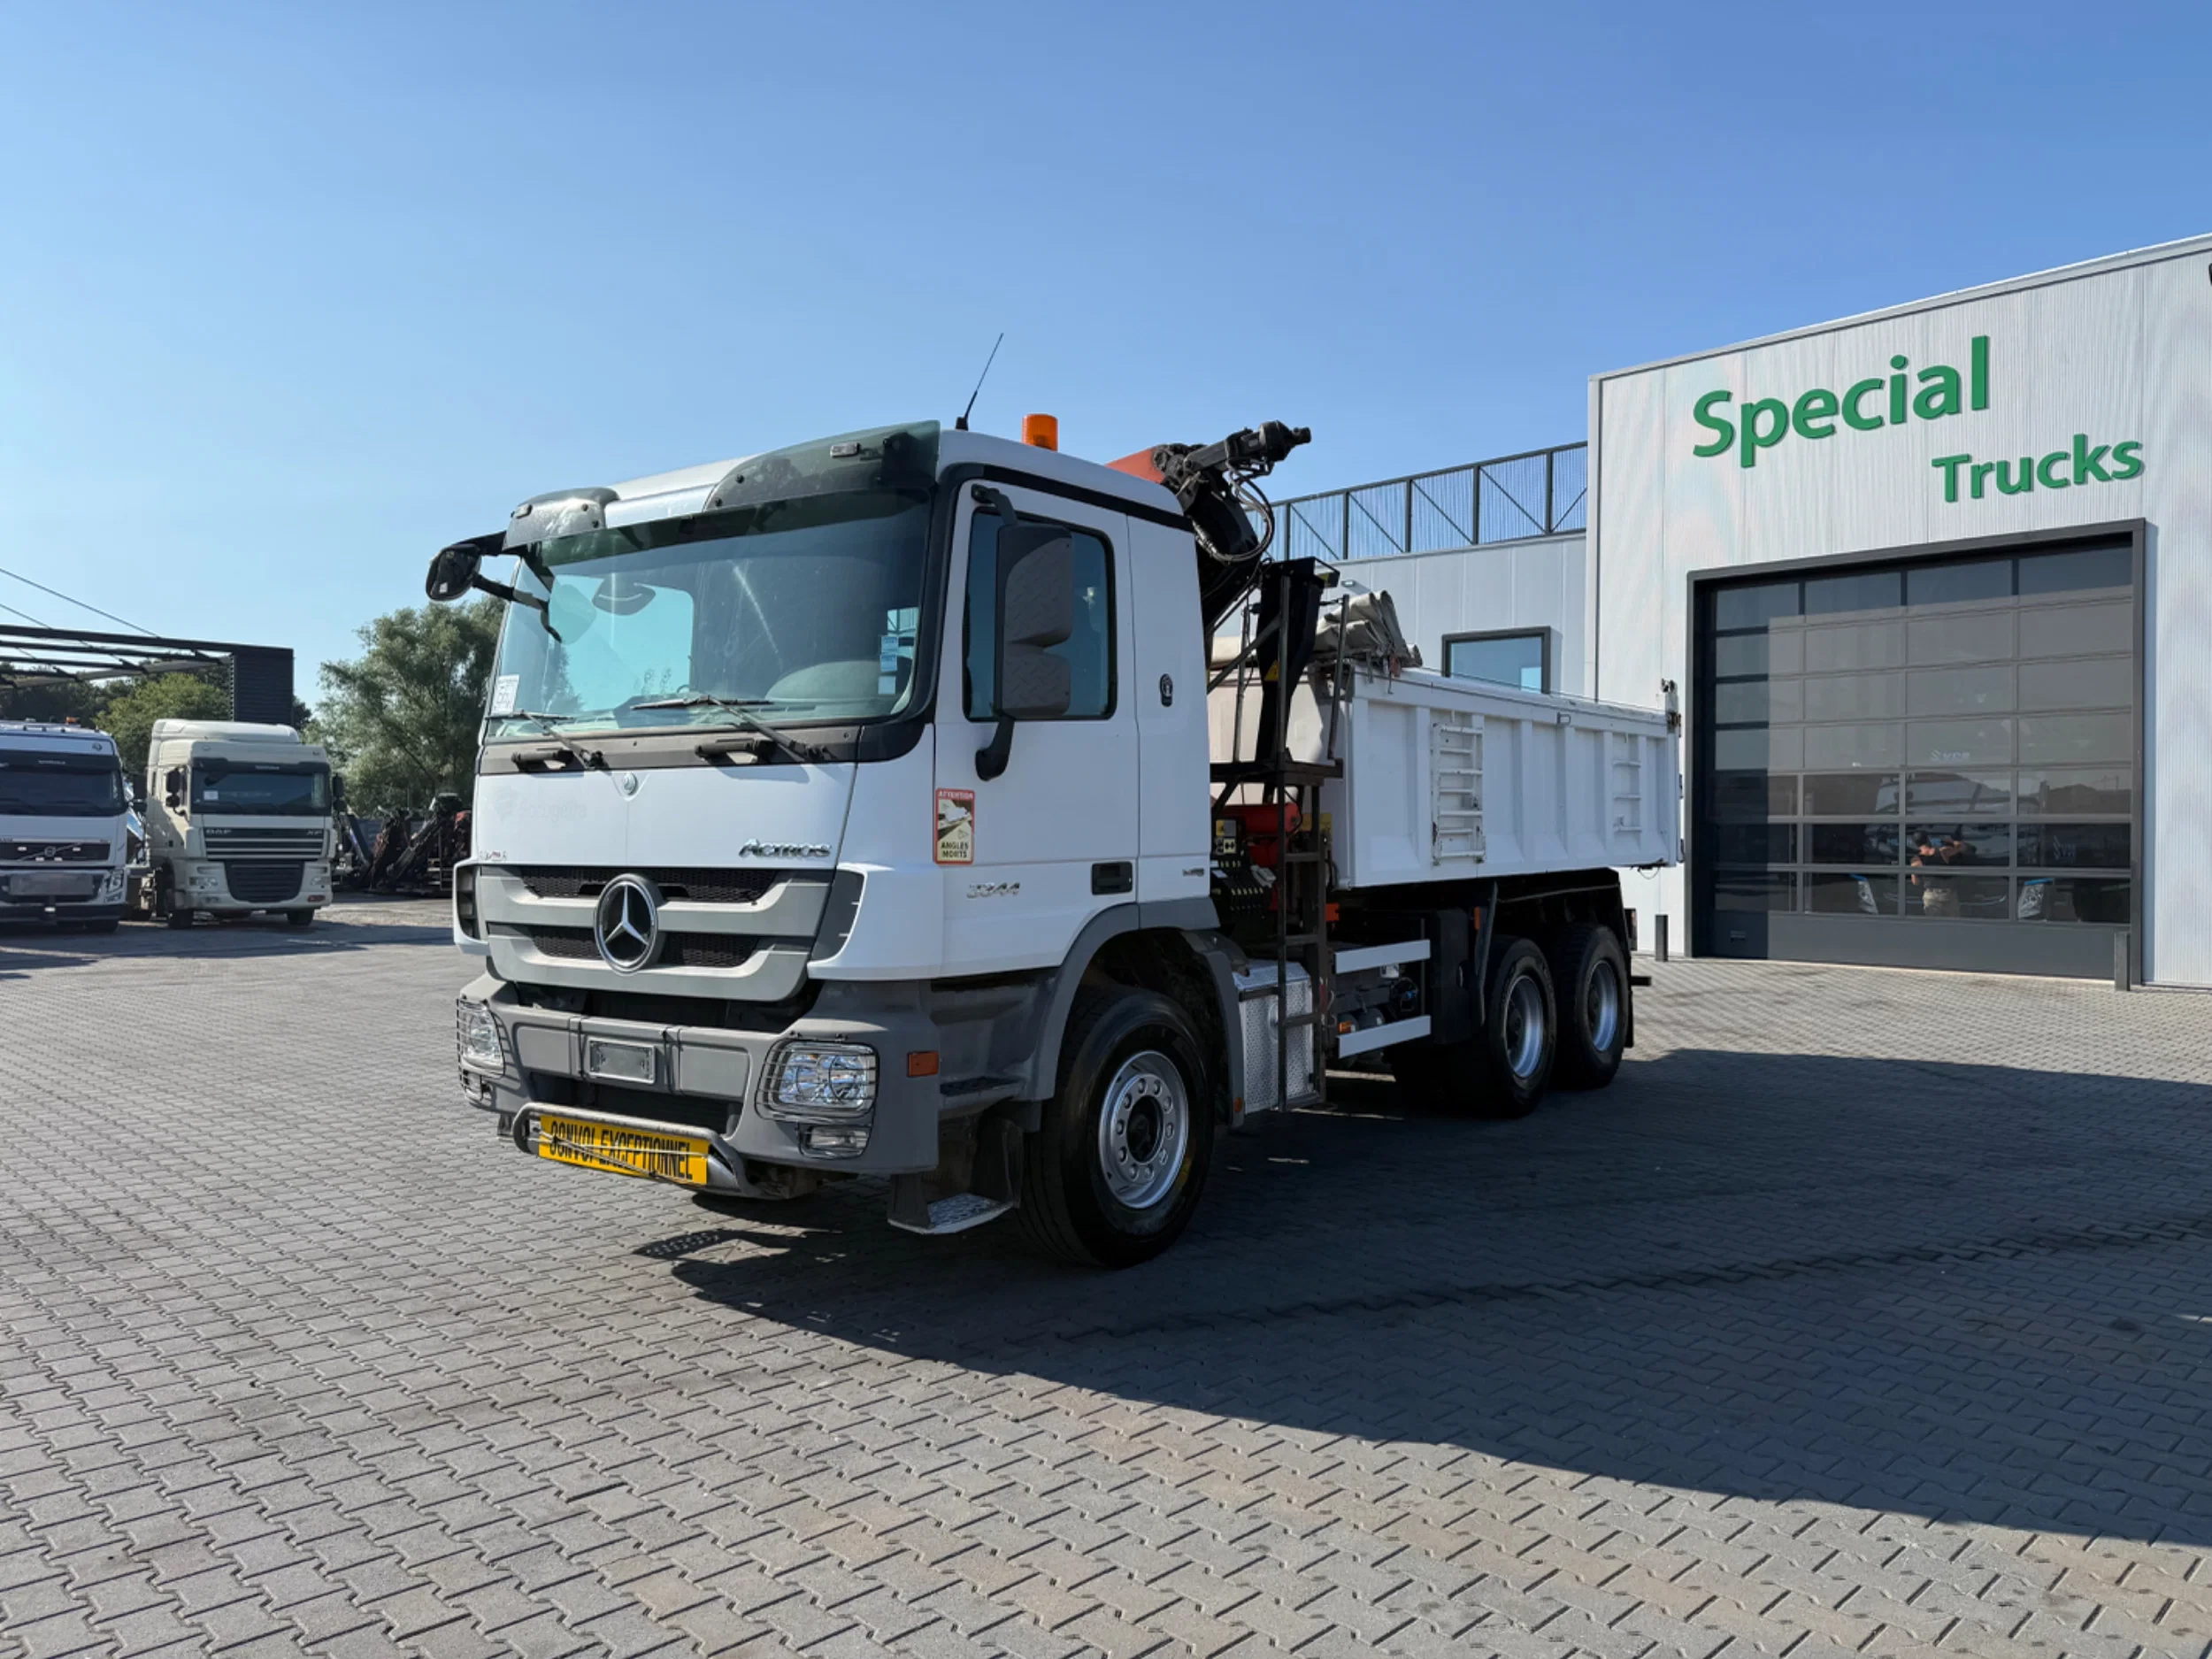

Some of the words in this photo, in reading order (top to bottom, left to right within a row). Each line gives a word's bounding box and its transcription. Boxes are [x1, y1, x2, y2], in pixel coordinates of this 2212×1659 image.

[1693, 334, 1990, 468] Special
[1932, 434, 2145, 503] Trucks
[939, 790, 973, 799] ATTENTION
[739, 839, 832, 858] Actros
[941, 841, 969, 850] ANGLES
